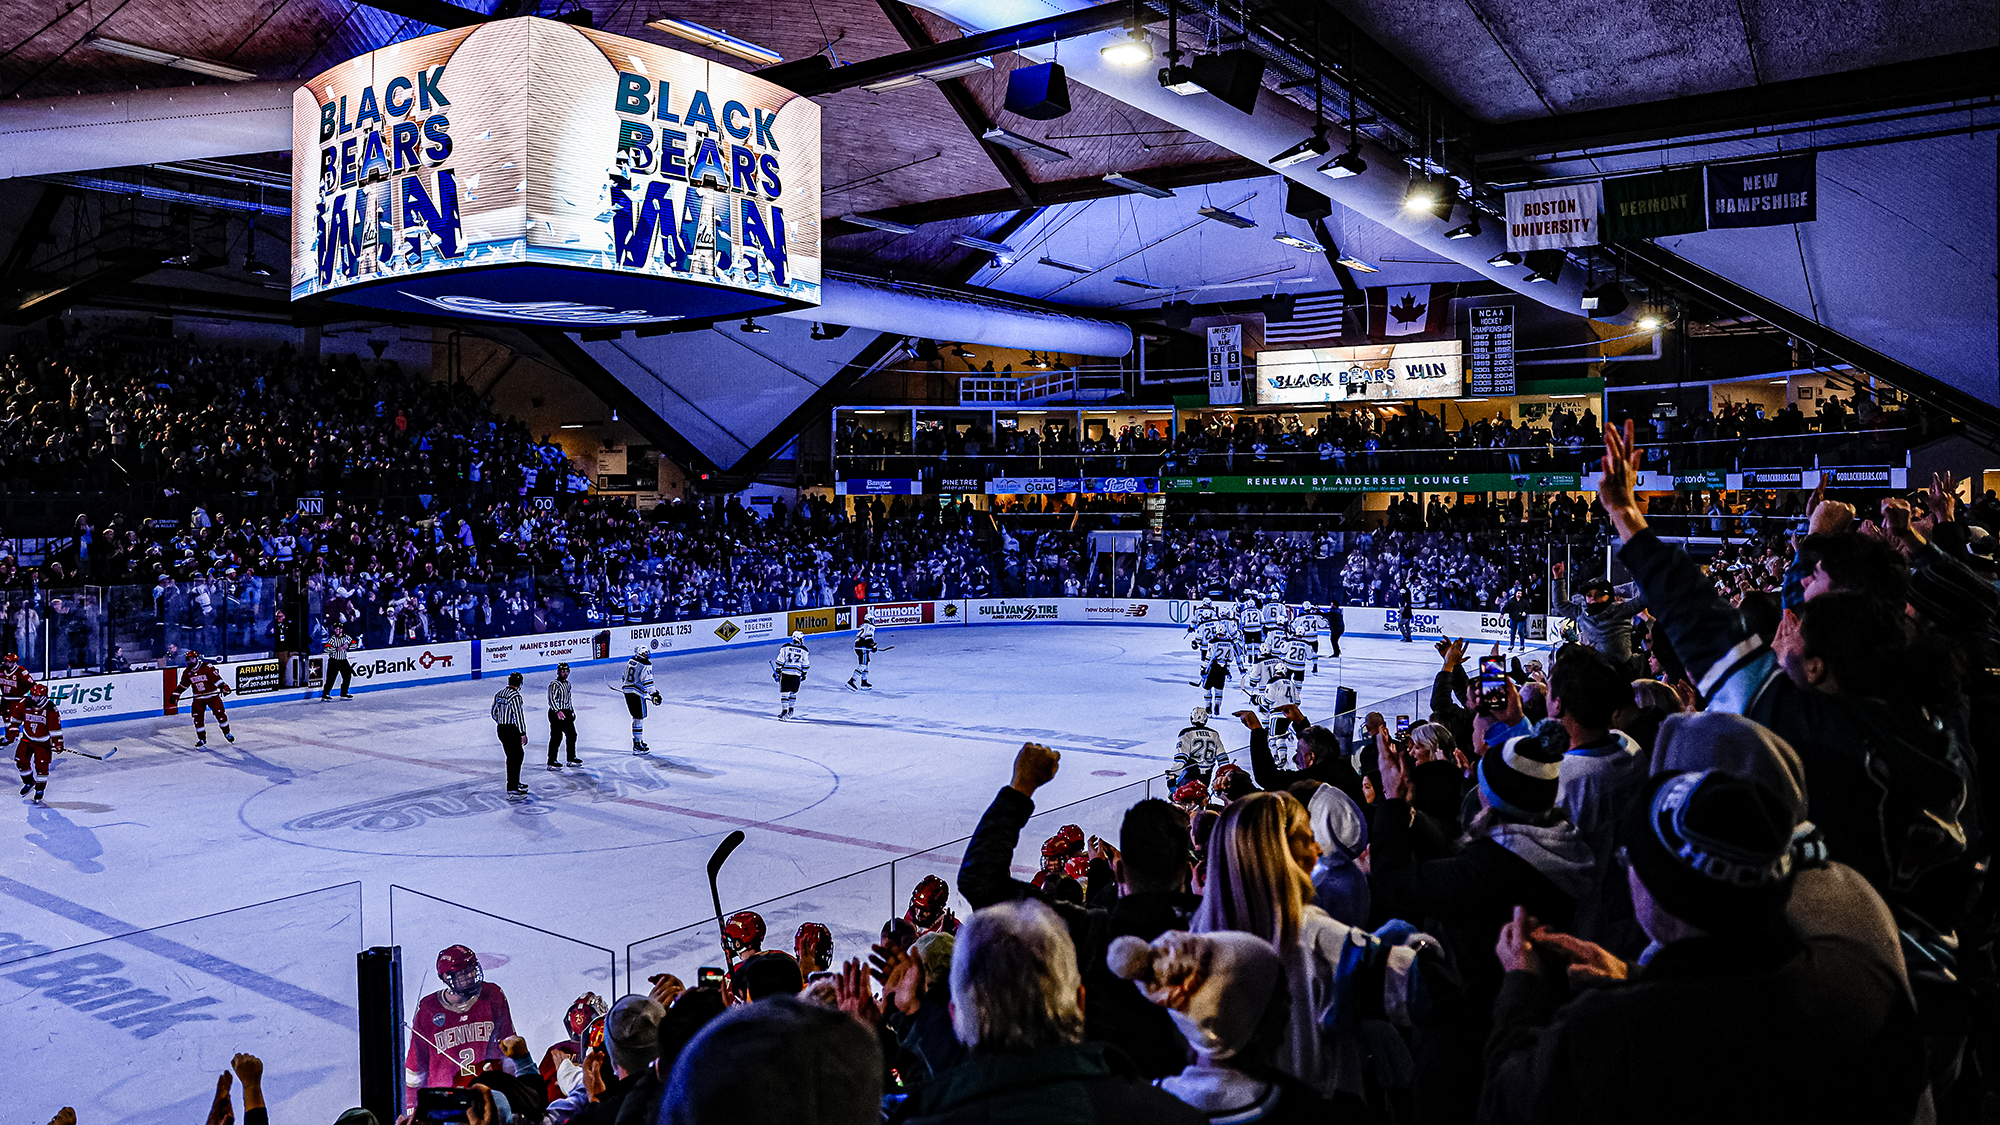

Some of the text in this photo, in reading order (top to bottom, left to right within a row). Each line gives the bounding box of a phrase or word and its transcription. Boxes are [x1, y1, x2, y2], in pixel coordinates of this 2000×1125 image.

[319, 65, 452, 145] BLACK
[615, 70, 781, 153] BLACK
[320, 114, 454, 196] BEARS
[616, 119, 782, 201] BEARS
[1743, 173, 1778, 191] NEW
[1524, 198, 1576, 218] BOSTON
[1619, 194, 1688, 216] VERMONT
[1716, 191, 1808, 214] HAMPSHIRE
[315, 168, 466, 286] WIN
[609, 172, 791, 288] WIN
[1512, 217, 1590, 238] UNIVERSITY
[1274, 362, 1447, 388] BLACK BEARS WIN
[1335, 477, 1406, 485] ANDERSEN
[1414, 476, 1469, 484] LOUNGE
[1756, 473, 1800, 482] GOBLACKBEARS.COM
[1837, 472, 1888, 481] GOBLACKBEARS.COM
[299, 500, 321, 513] NN
[867, 603, 922, 616] Hammond
[979, 604, 1058, 615] SULLIVAN TIRE
[1247, 613, 1258, 622] 12
[1270, 607, 1277, 617] 6
[745, 622, 773, 630] TOGETHER
[795, 616, 828, 629] Milton
[836, 612, 850, 625] CAT
[1303, 620, 1317, 631] 34
[630, 624, 692, 640] IBEW LOCAL 1253
[1384, 623, 1443, 634] Savgs Bank
[520, 642, 548, 651] MAINE'S
[1216, 648, 1231, 661] 24
[1290, 647, 1305, 660] 28
[787, 653, 801, 662] 17
[239, 665, 263, 674] ARMY
[350, 657, 417, 679] KeyBank
[50, 682, 114, 706] iFirst
[1285, 686, 1293, 703] 4
[82, 704, 113, 713] Solutions
[1190, 738, 1216, 764] 26
[3, 952, 223, 1040] Bank
[433, 1020, 495, 1054] DENVER
[459, 1047, 476, 1076] 2
